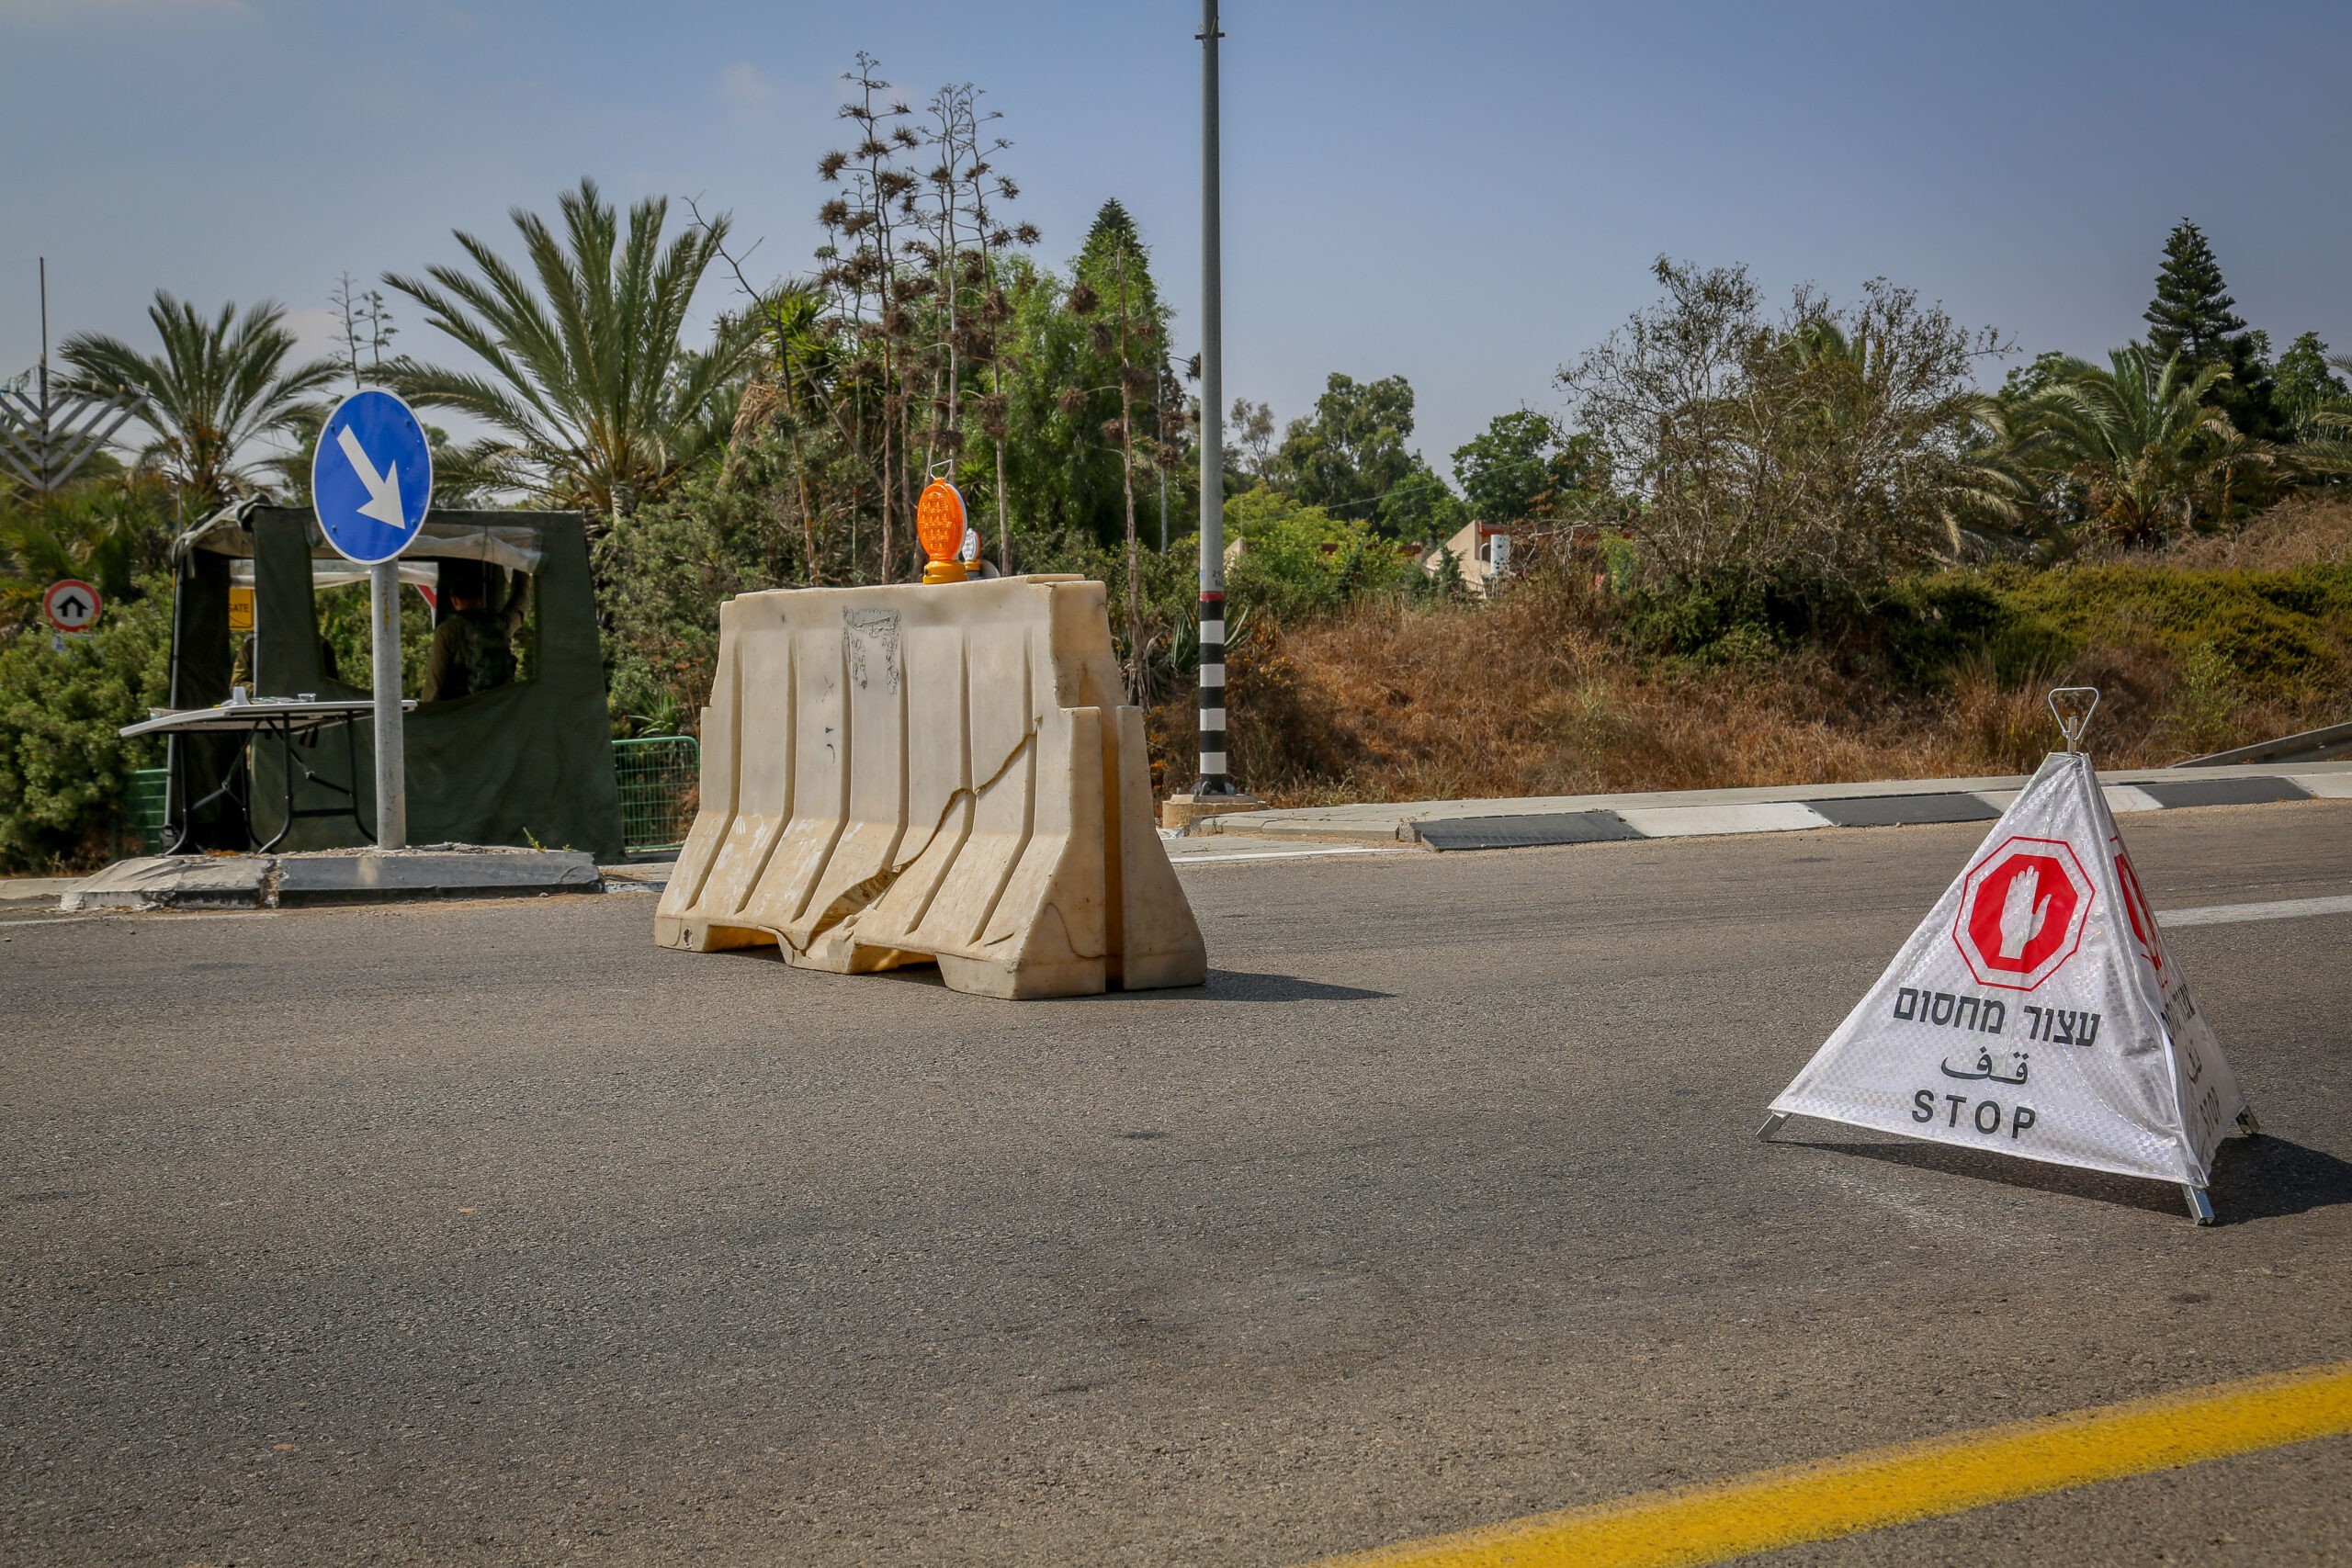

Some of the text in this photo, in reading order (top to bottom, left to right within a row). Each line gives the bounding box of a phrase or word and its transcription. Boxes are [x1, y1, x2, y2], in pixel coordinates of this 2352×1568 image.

[1893, 987, 2101, 1046] עצור מחסום
[1940, 1045, 2030, 1085] قف
[1912, 1089, 2036, 1139] STOP
[2199, 1086, 2222, 1138] STOP
